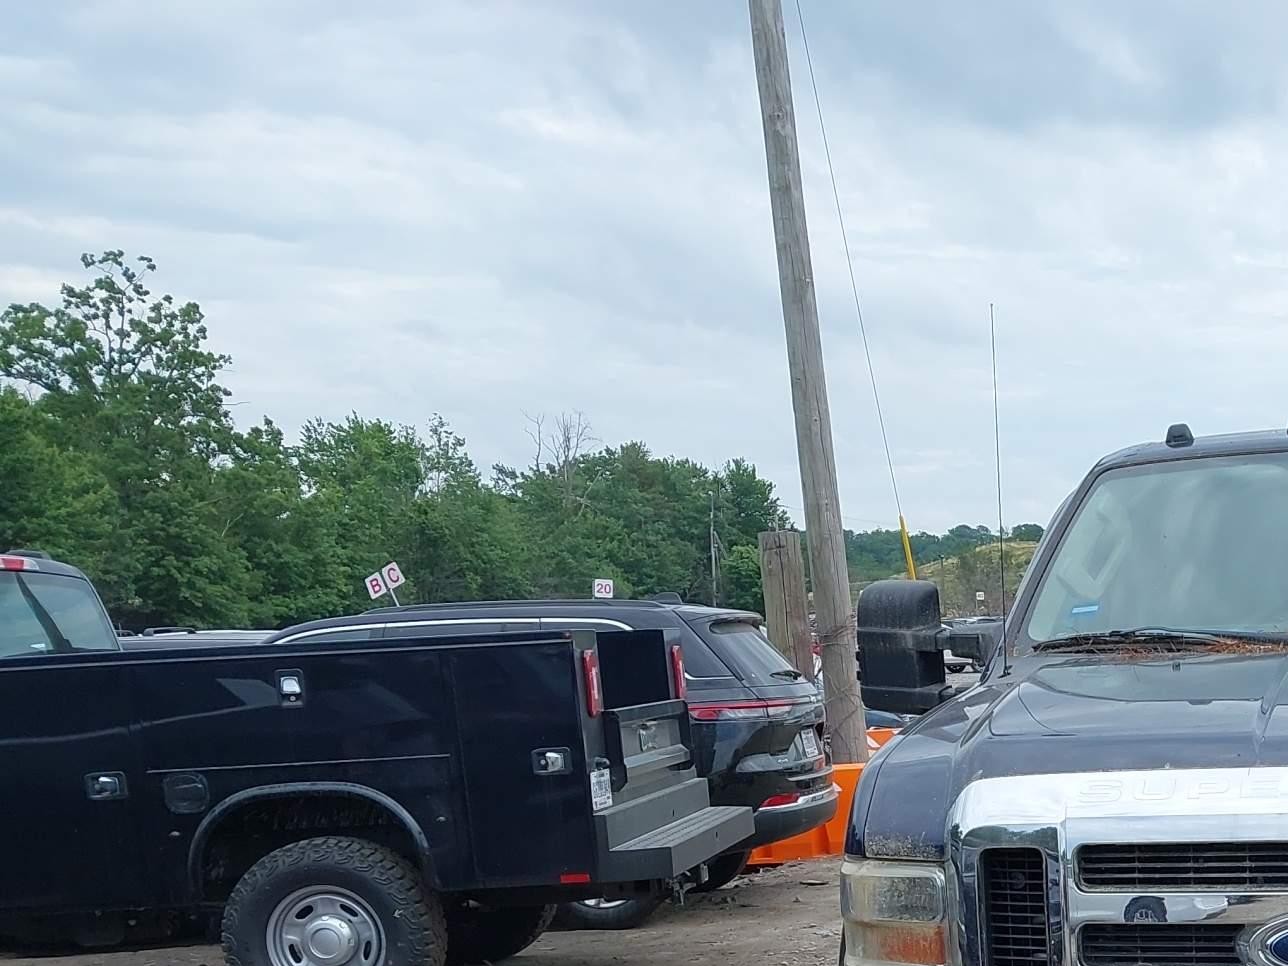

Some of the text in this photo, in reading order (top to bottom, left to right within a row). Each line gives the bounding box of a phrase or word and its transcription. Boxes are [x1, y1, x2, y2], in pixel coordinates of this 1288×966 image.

[369, 566, 401, 595] B C
[595, 583, 612, 595] 20
